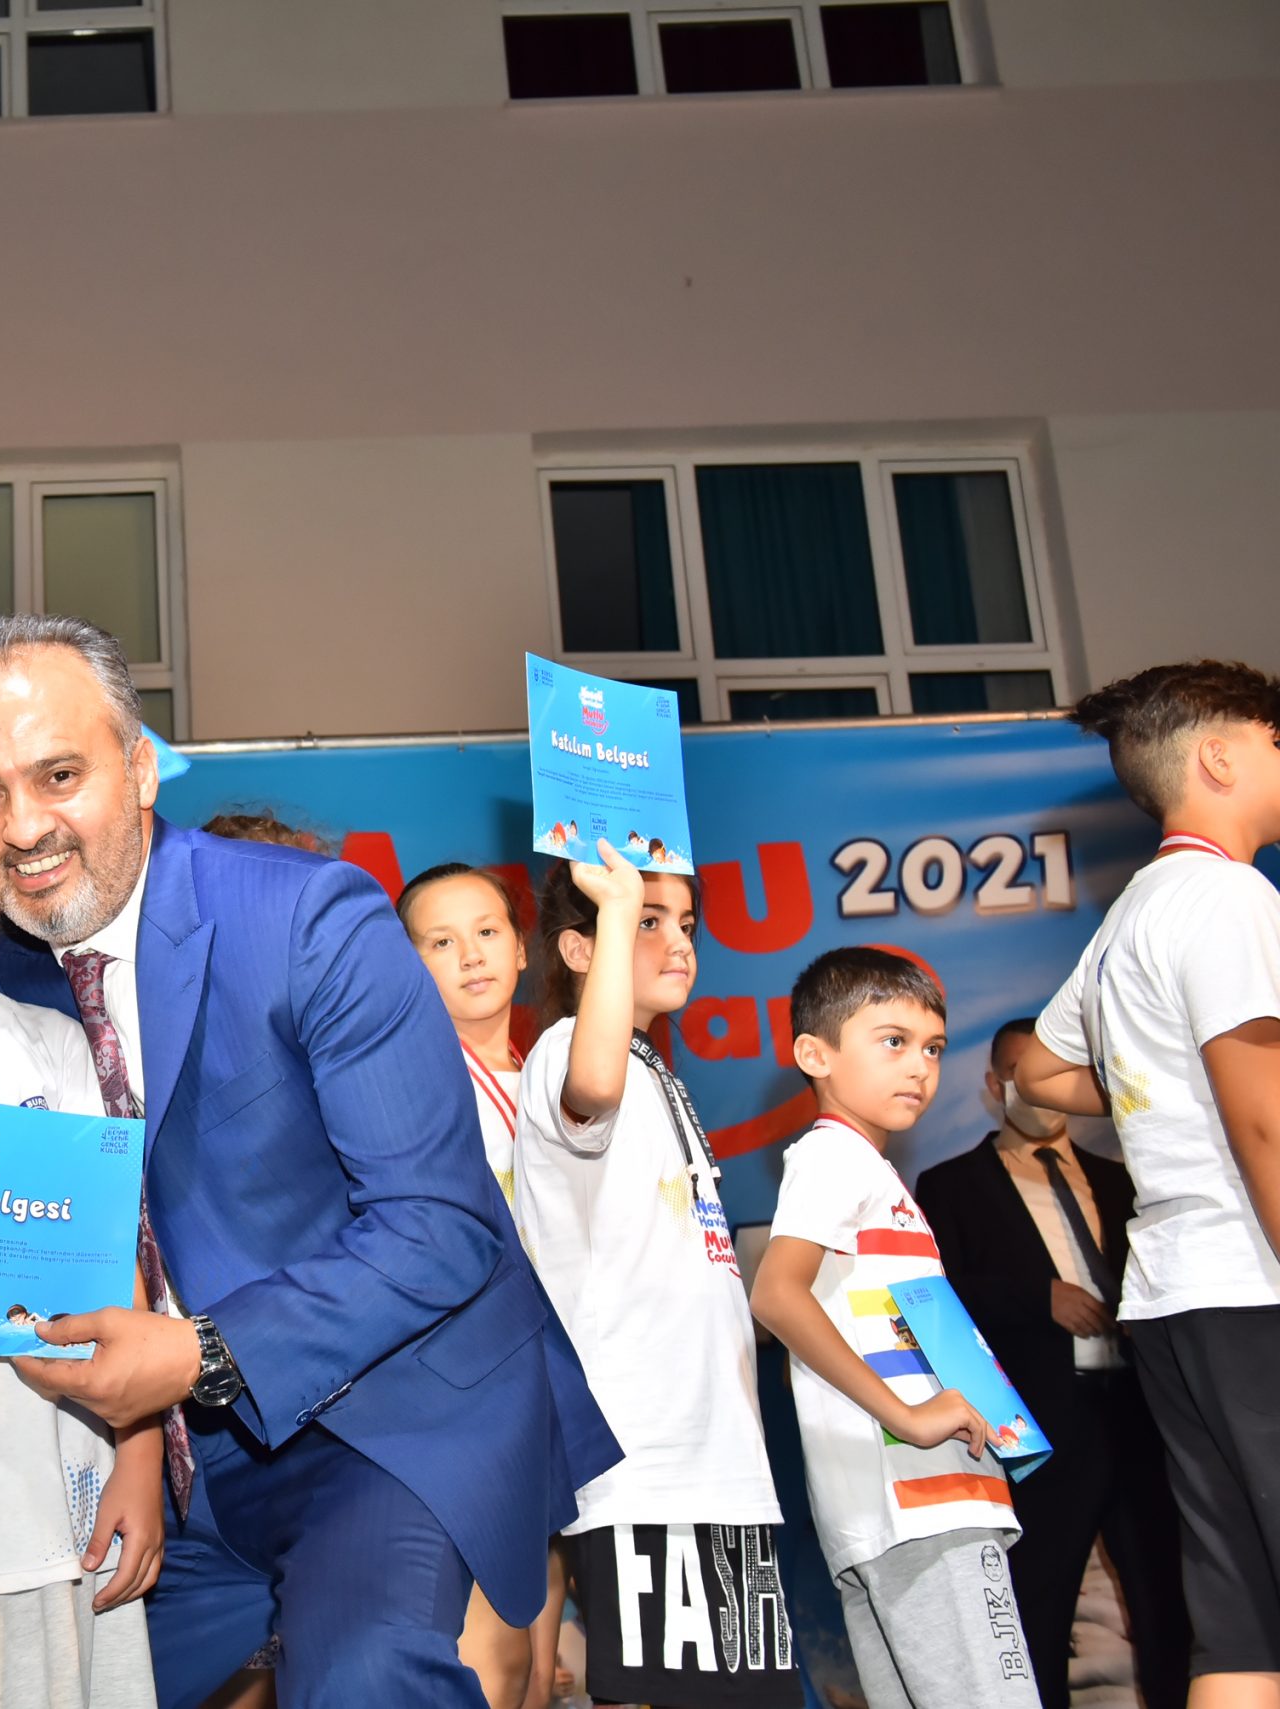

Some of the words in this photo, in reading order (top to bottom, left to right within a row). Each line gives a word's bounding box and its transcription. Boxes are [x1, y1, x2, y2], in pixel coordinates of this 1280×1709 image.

[551, 730, 593, 759] Katılım
[596, 742, 650, 770] Belgesi
[829, 830, 1077, 920] 2021
[630, 1037, 667, 1074] SELFIE
[983, 1587, 1029, 1680] BJK
